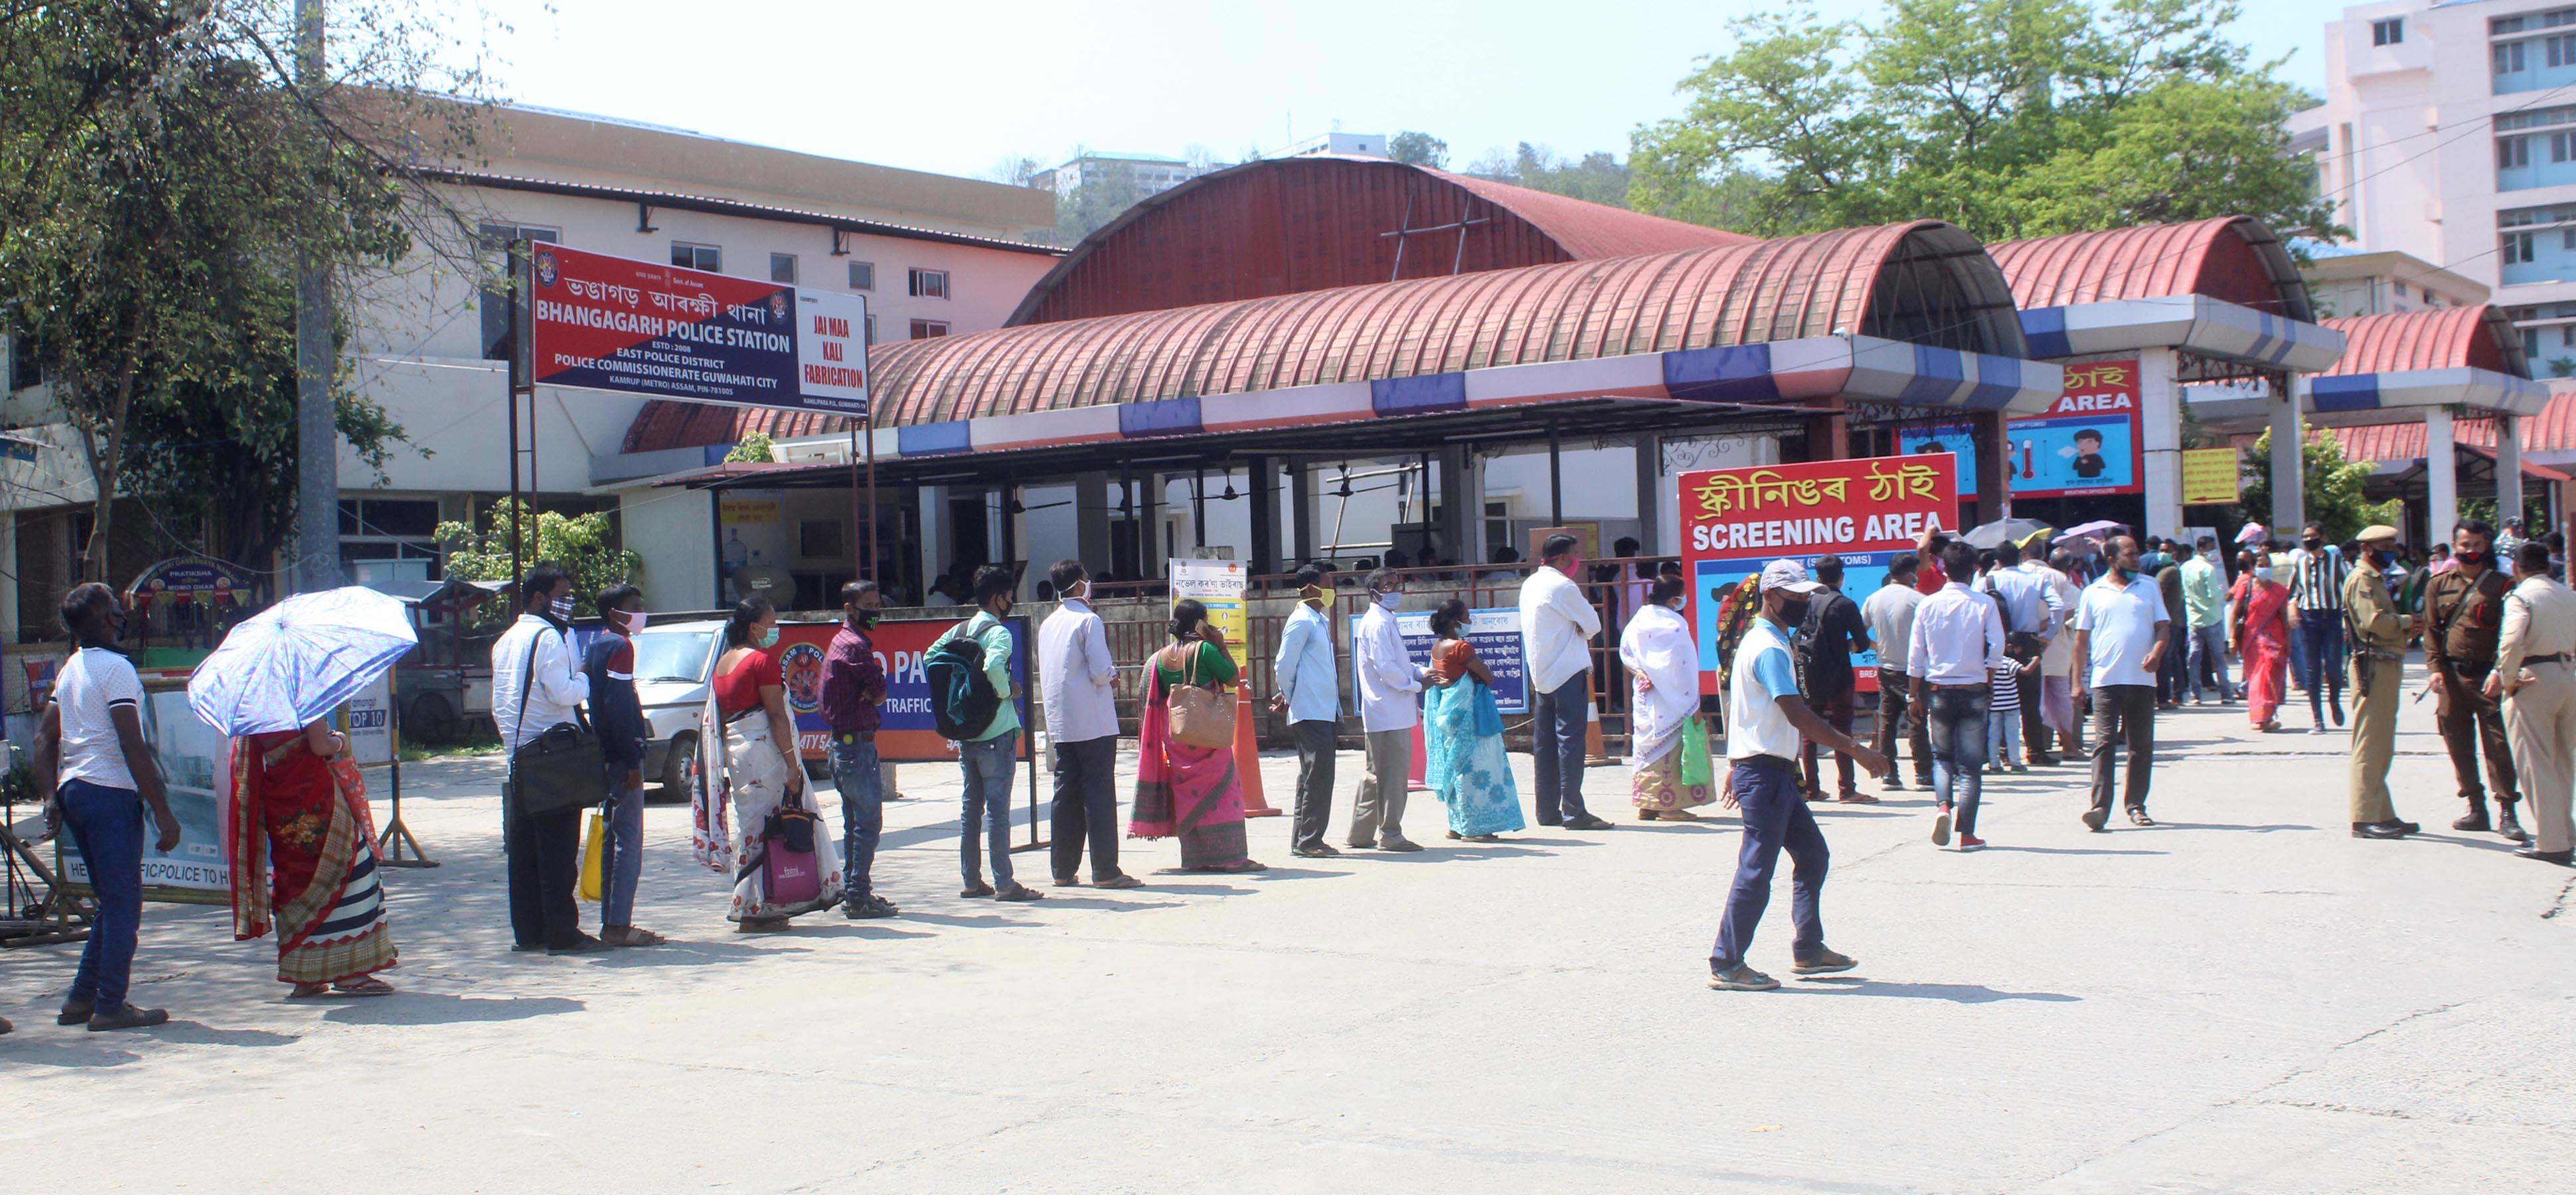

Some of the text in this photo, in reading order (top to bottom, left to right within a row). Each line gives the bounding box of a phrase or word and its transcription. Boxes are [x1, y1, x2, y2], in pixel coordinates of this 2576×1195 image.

[648, 291, 718, 318] আৰক্ষী
[726, 303, 767, 325] থানা
[536, 299, 790, 353] BHANGAGARH POLICE STATION
[814, 315, 849, 338] JAI MAA
[652, 341, 670, 351] ESTD
[674, 344, 691, 353] 2008
[823, 341, 843, 362] KALI
[617, 347, 725, 369] EAST POLICE DISTRICT
[554, 353, 777, 389] POLICE COMMISSIONERATE GUWAHATI CITY
[804, 364, 863, 389] FABRICATION
[609, 375, 733, 396] KAMRUP (METRO) ASSAM, PIN-781005
[2057, 392, 2133, 413] AREA
[1863, 461, 1941, 502] ঠাই
[1692, 511, 1942, 552] SCREENING AREA
[809, 647, 825, 663] POL
[886, 698, 931, 713] TRAFFIC
[371, 711, 383, 726] 10
[202, 868, 216, 884] TO
